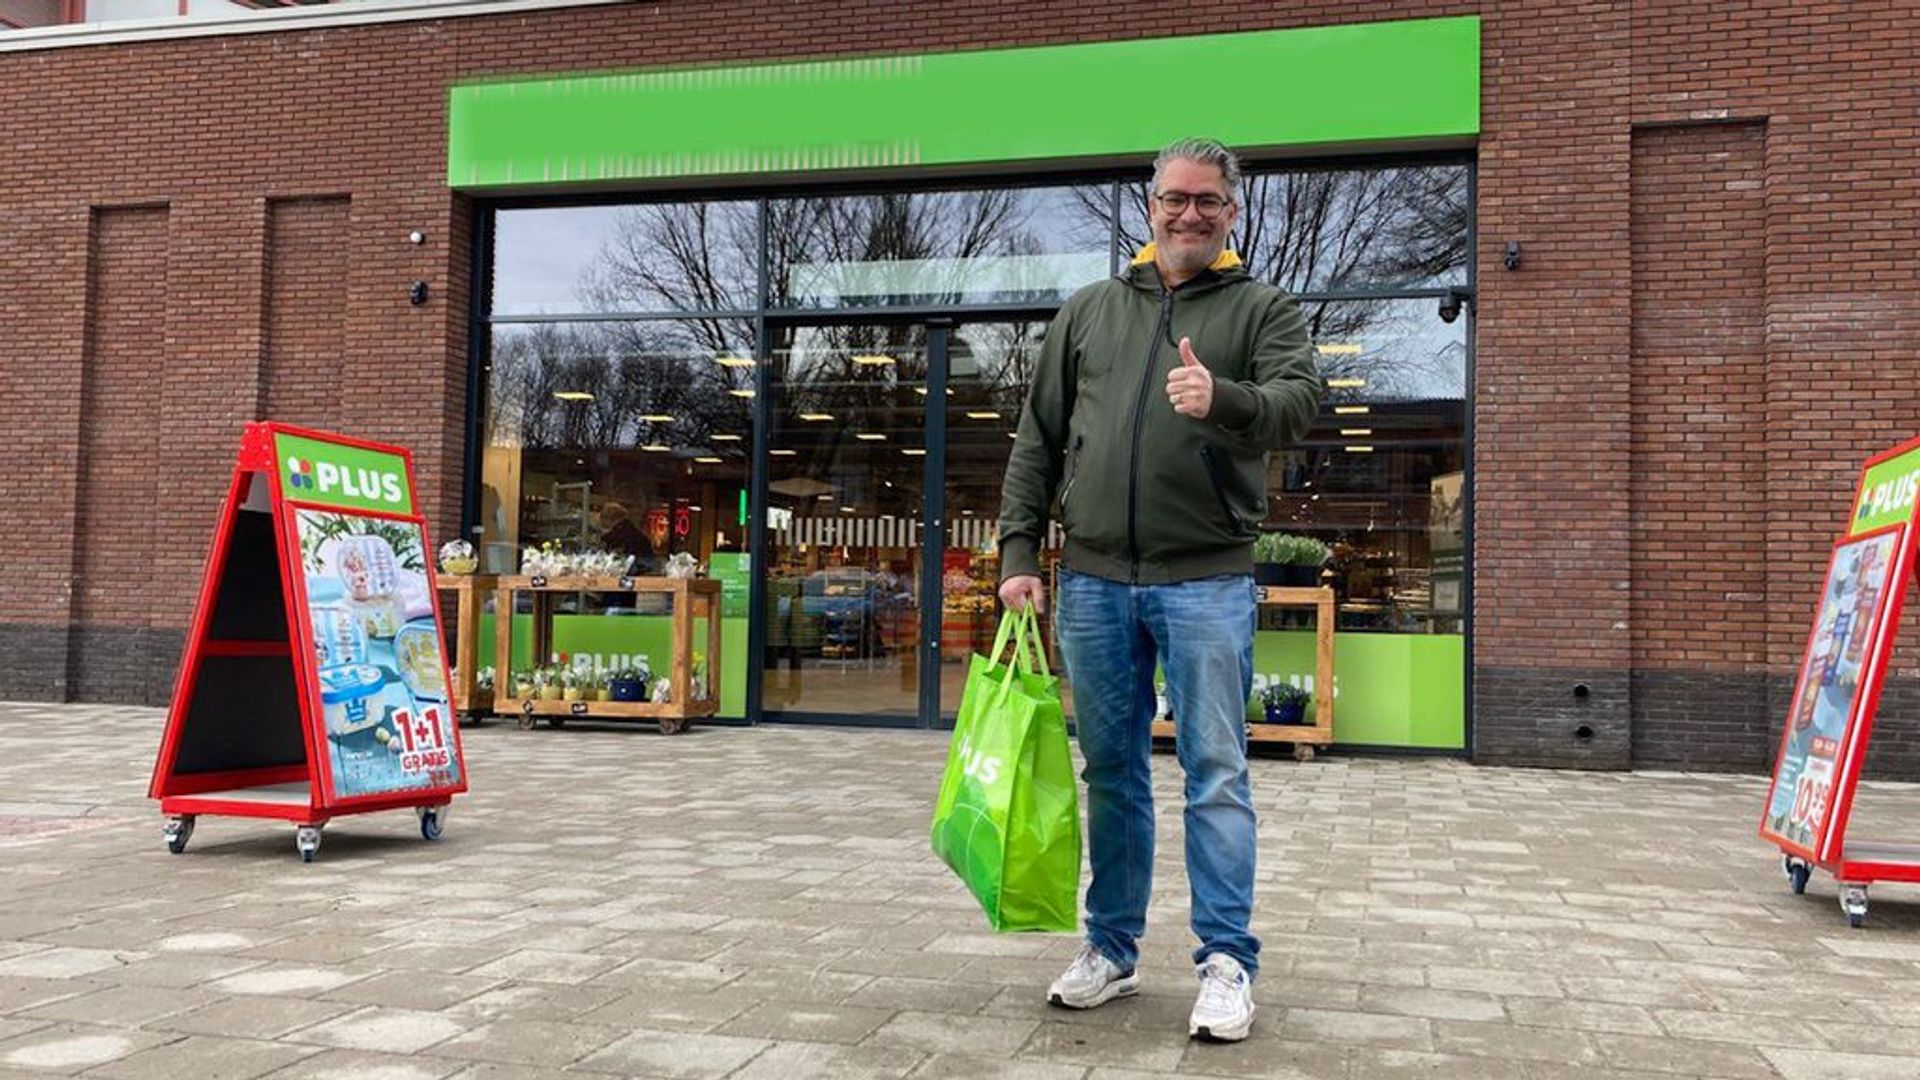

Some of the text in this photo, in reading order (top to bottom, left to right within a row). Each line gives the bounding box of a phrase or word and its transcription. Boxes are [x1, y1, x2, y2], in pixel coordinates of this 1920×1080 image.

[316, 461, 402, 502] PLUS
[1871, 470, 1920, 517] PLUS
[395, 708, 442, 752] 1+1
[402, 751, 449, 770] GRATIS
